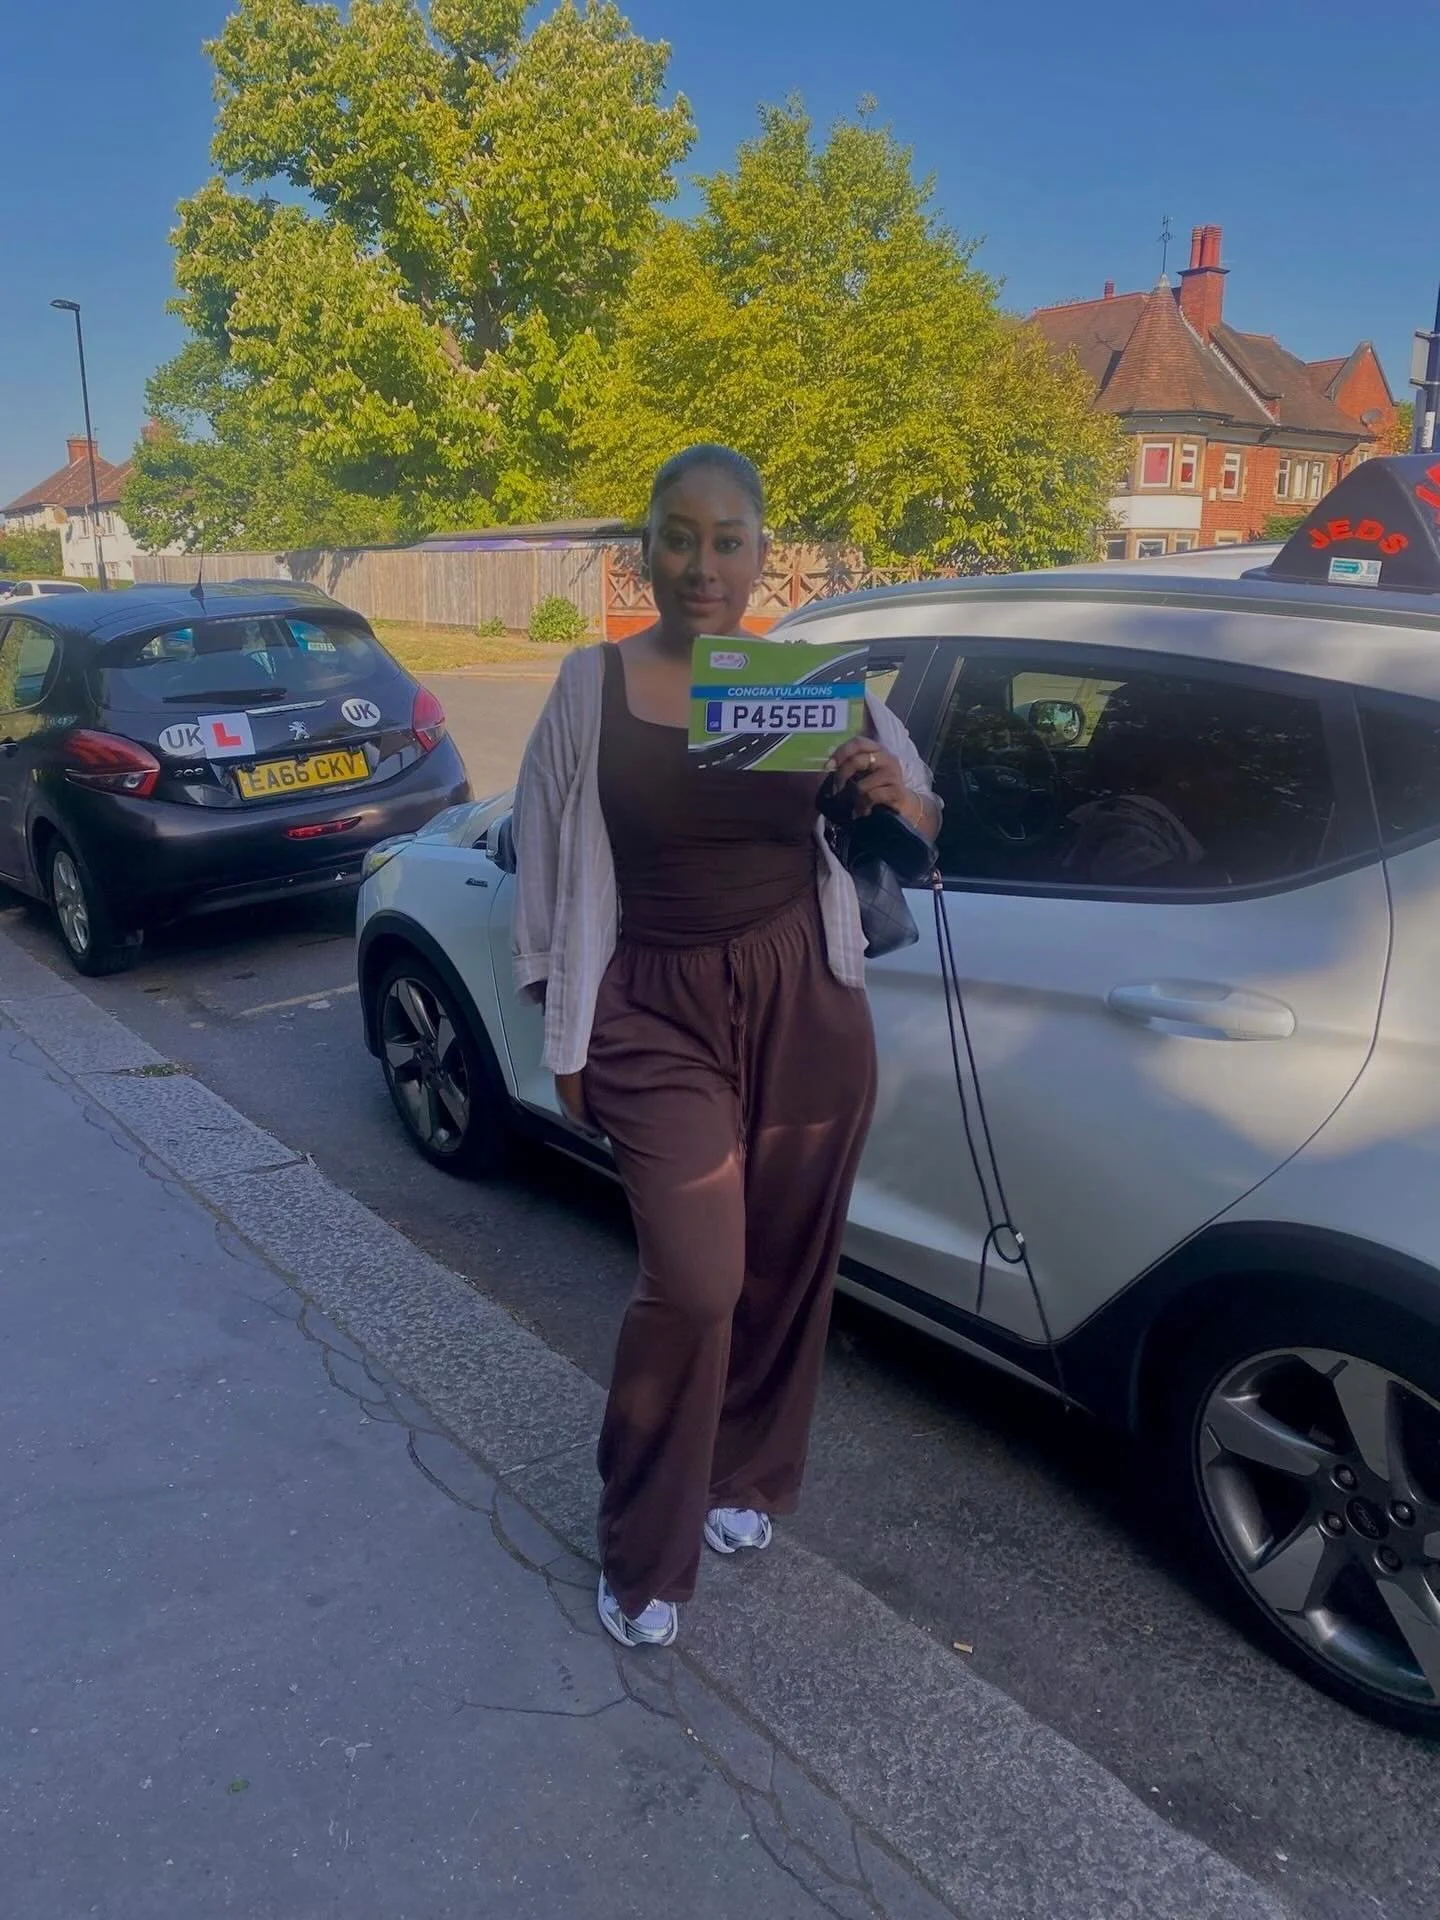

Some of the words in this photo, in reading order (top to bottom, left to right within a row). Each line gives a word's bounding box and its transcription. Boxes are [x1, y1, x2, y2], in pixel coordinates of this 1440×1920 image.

[1309, 518, 1408, 555] JEDS
[727, 686, 833, 697] CONGRATULATIONS
[345, 702, 376, 721] UK
[733, 705, 836, 728] P455ED
[166, 727, 203, 749] UK
[212, 722, 242, 748] L
[251, 762, 310, 792] EA66
